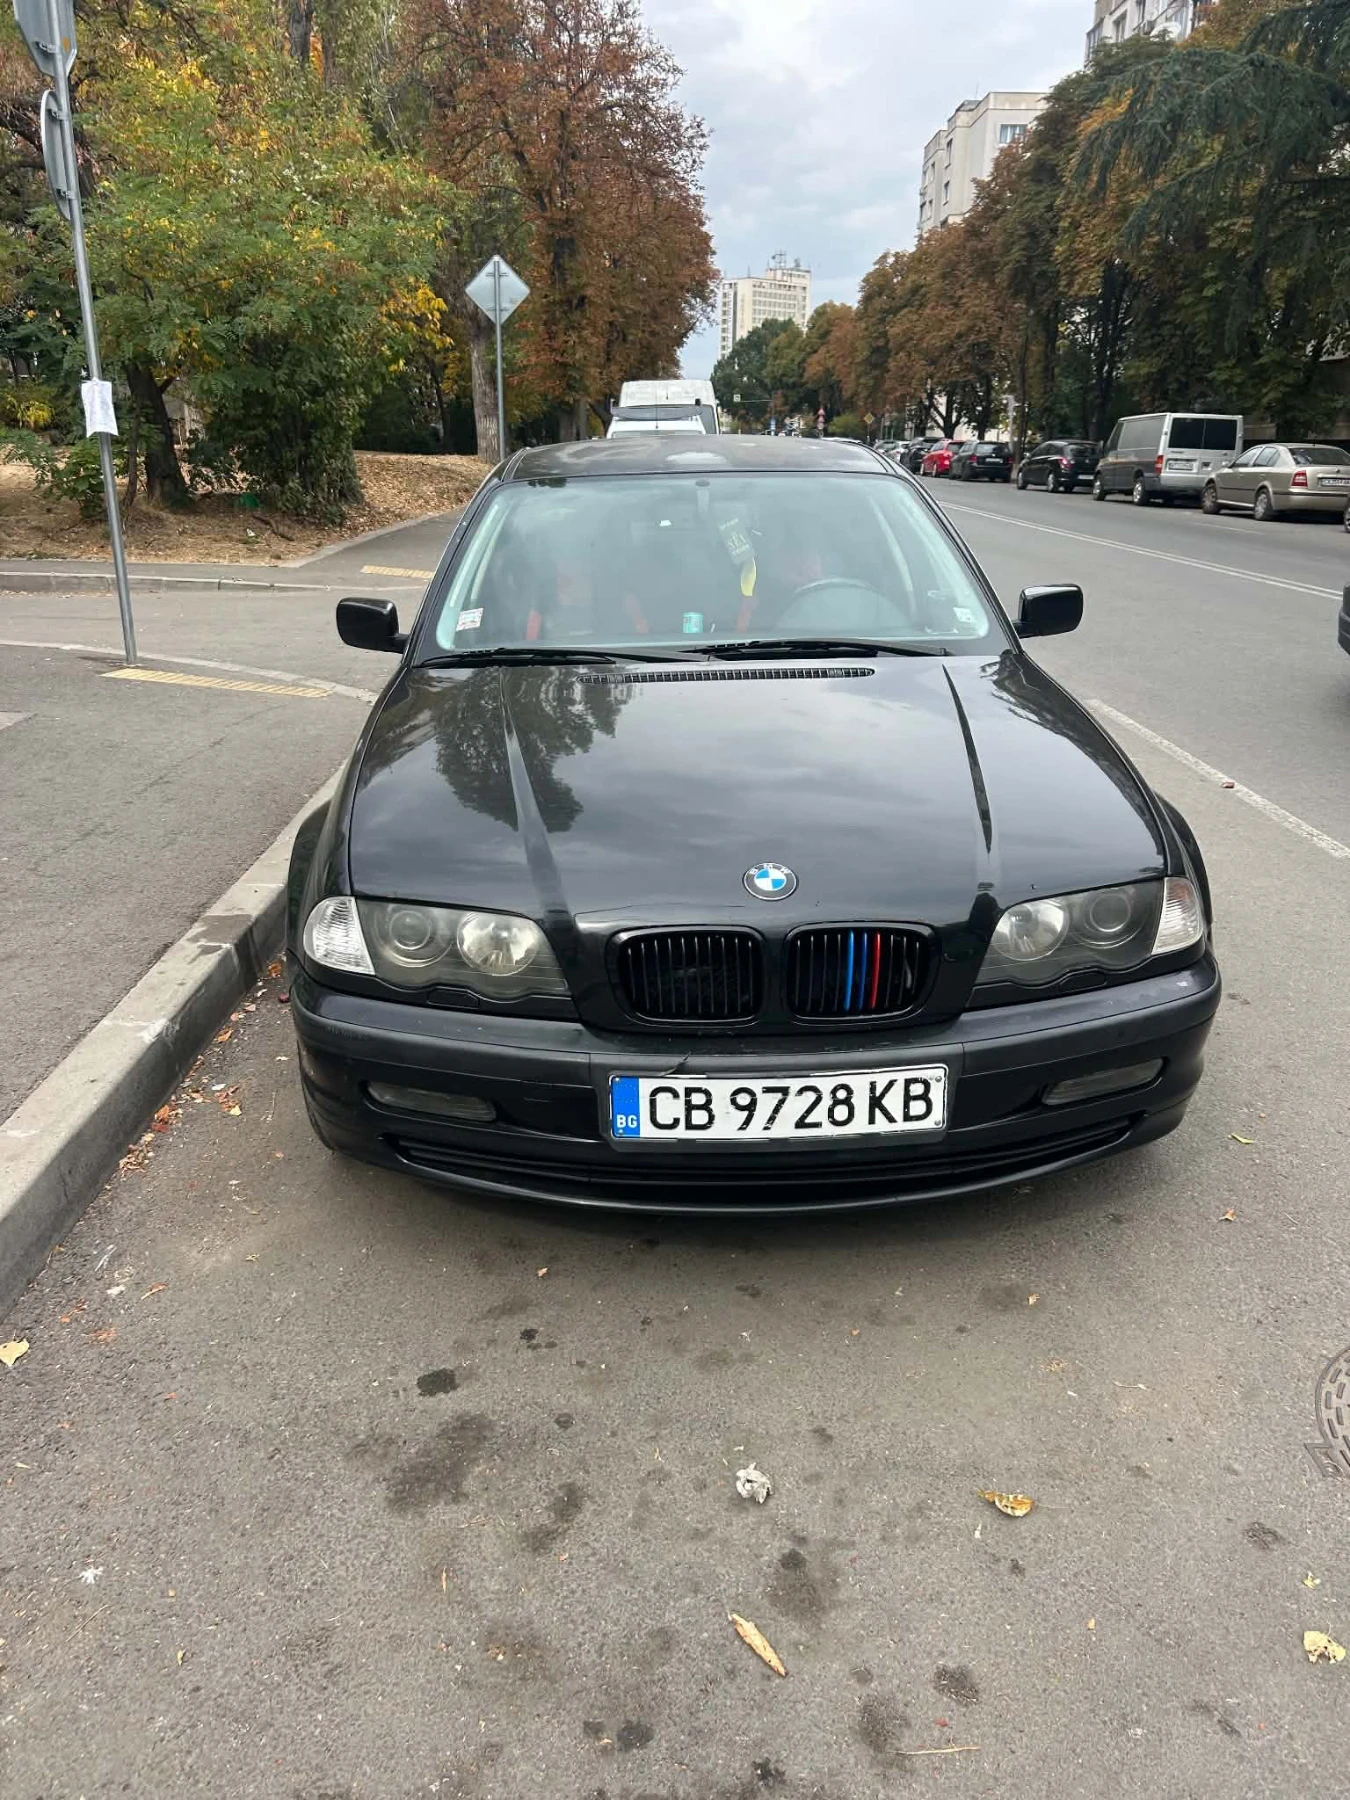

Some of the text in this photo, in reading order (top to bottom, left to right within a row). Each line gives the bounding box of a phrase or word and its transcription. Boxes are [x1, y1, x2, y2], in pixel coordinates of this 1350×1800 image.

[649, 1077, 934, 1131] CB 9728 KB
[616, 1114, 638, 1129] BG
